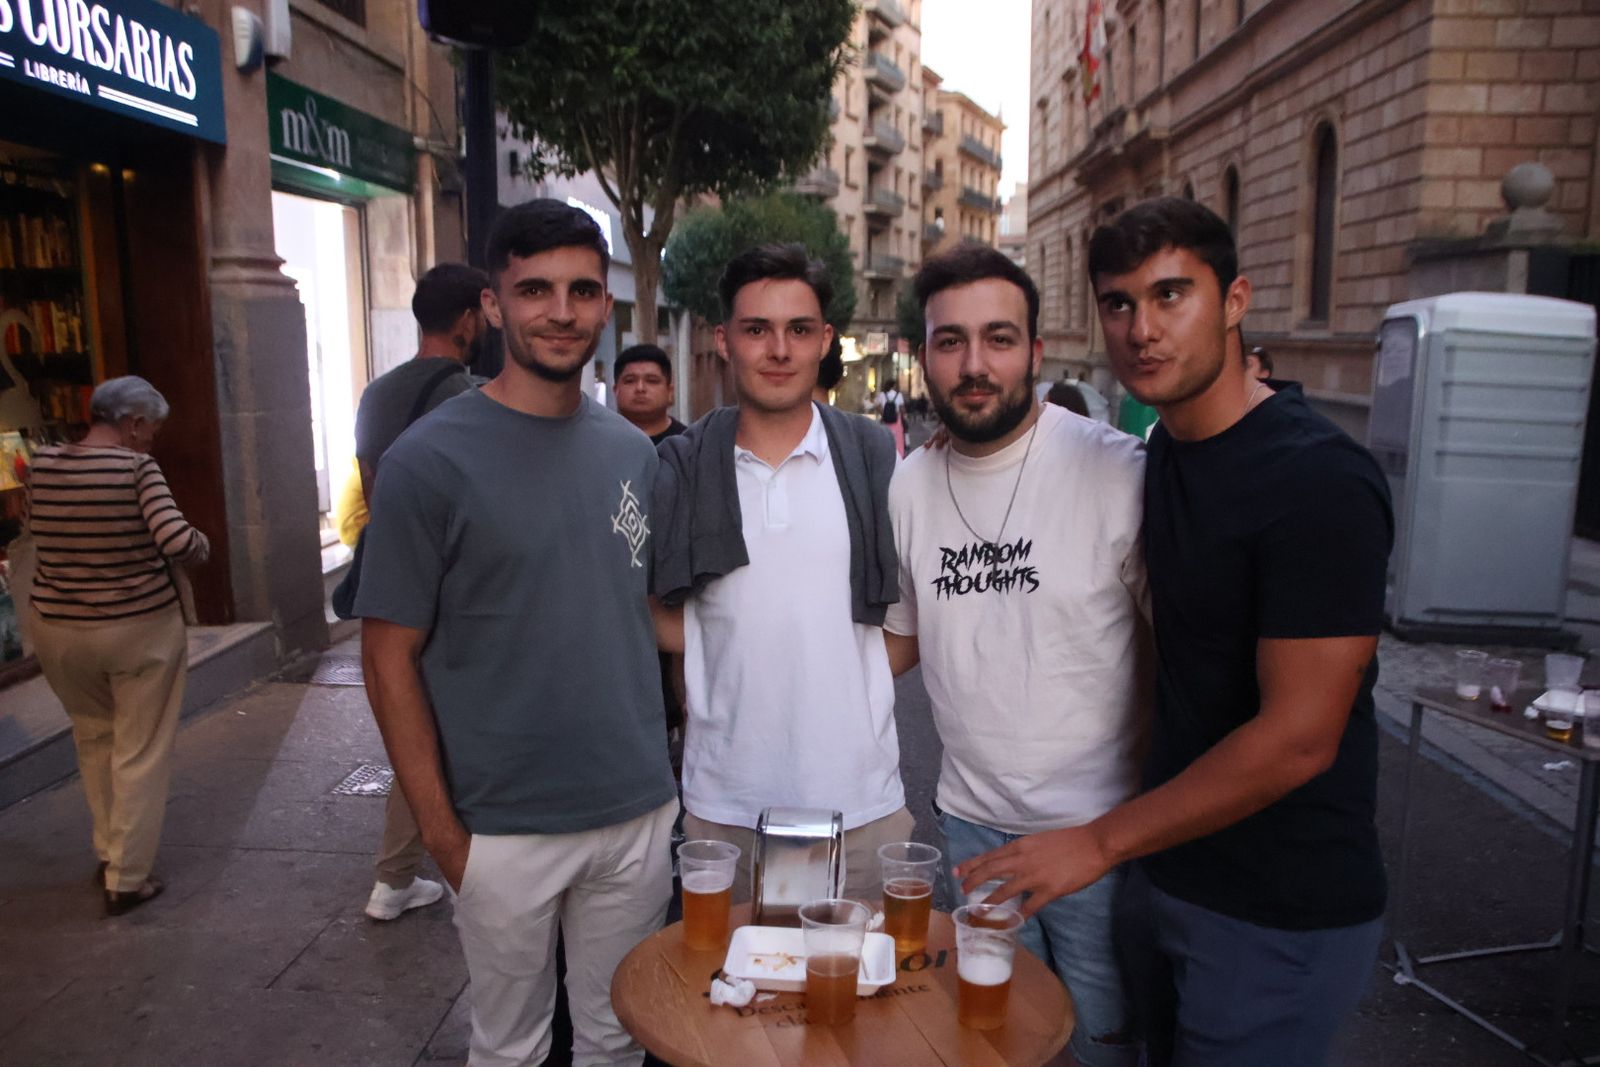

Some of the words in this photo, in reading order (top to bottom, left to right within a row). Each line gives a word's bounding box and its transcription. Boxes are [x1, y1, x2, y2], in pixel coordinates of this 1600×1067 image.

[23, 57, 91, 96] LIBRERÍA
[281, 96, 353, 168] m&m
[938, 536, 1033, 577] RANDOM
[931, 566, 1040, 600] THOUGHTS
